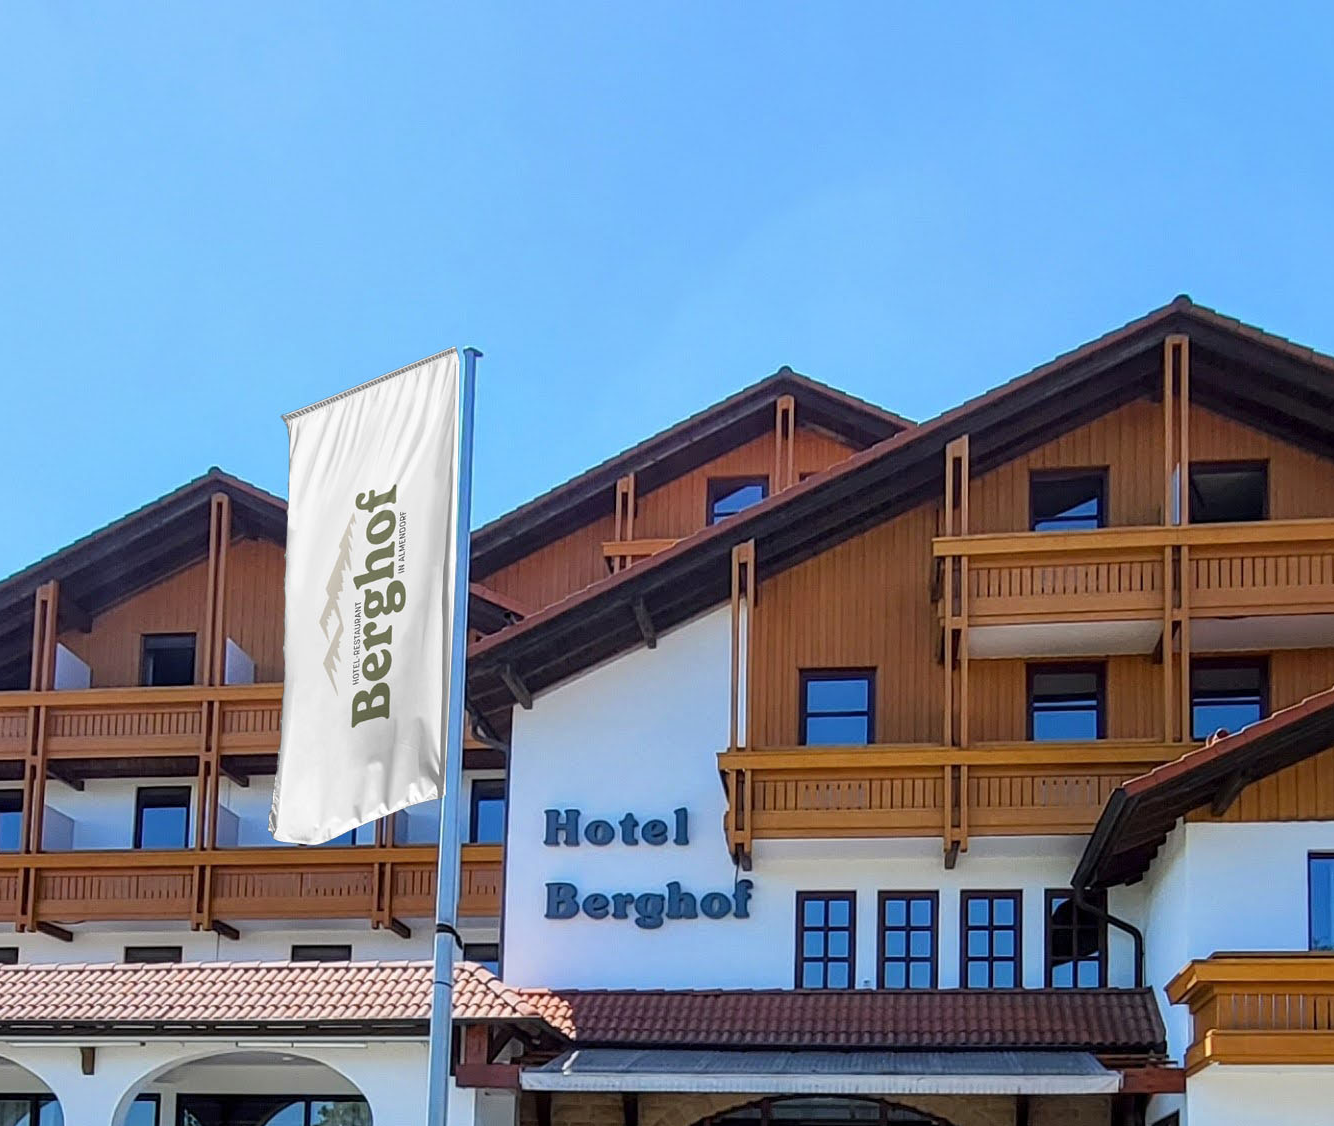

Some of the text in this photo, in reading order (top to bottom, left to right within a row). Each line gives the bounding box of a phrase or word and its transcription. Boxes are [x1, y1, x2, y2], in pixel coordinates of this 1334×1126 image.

[398, 512, 407, 574] IN ALMENDORF
[351, 484, 406, 728] Berghof
[352, 602, 362, 686] HOTEL-RESTAURANT
[543, 807, 690, 847] Hotel
[544, 879, 754, 930] Berghof
